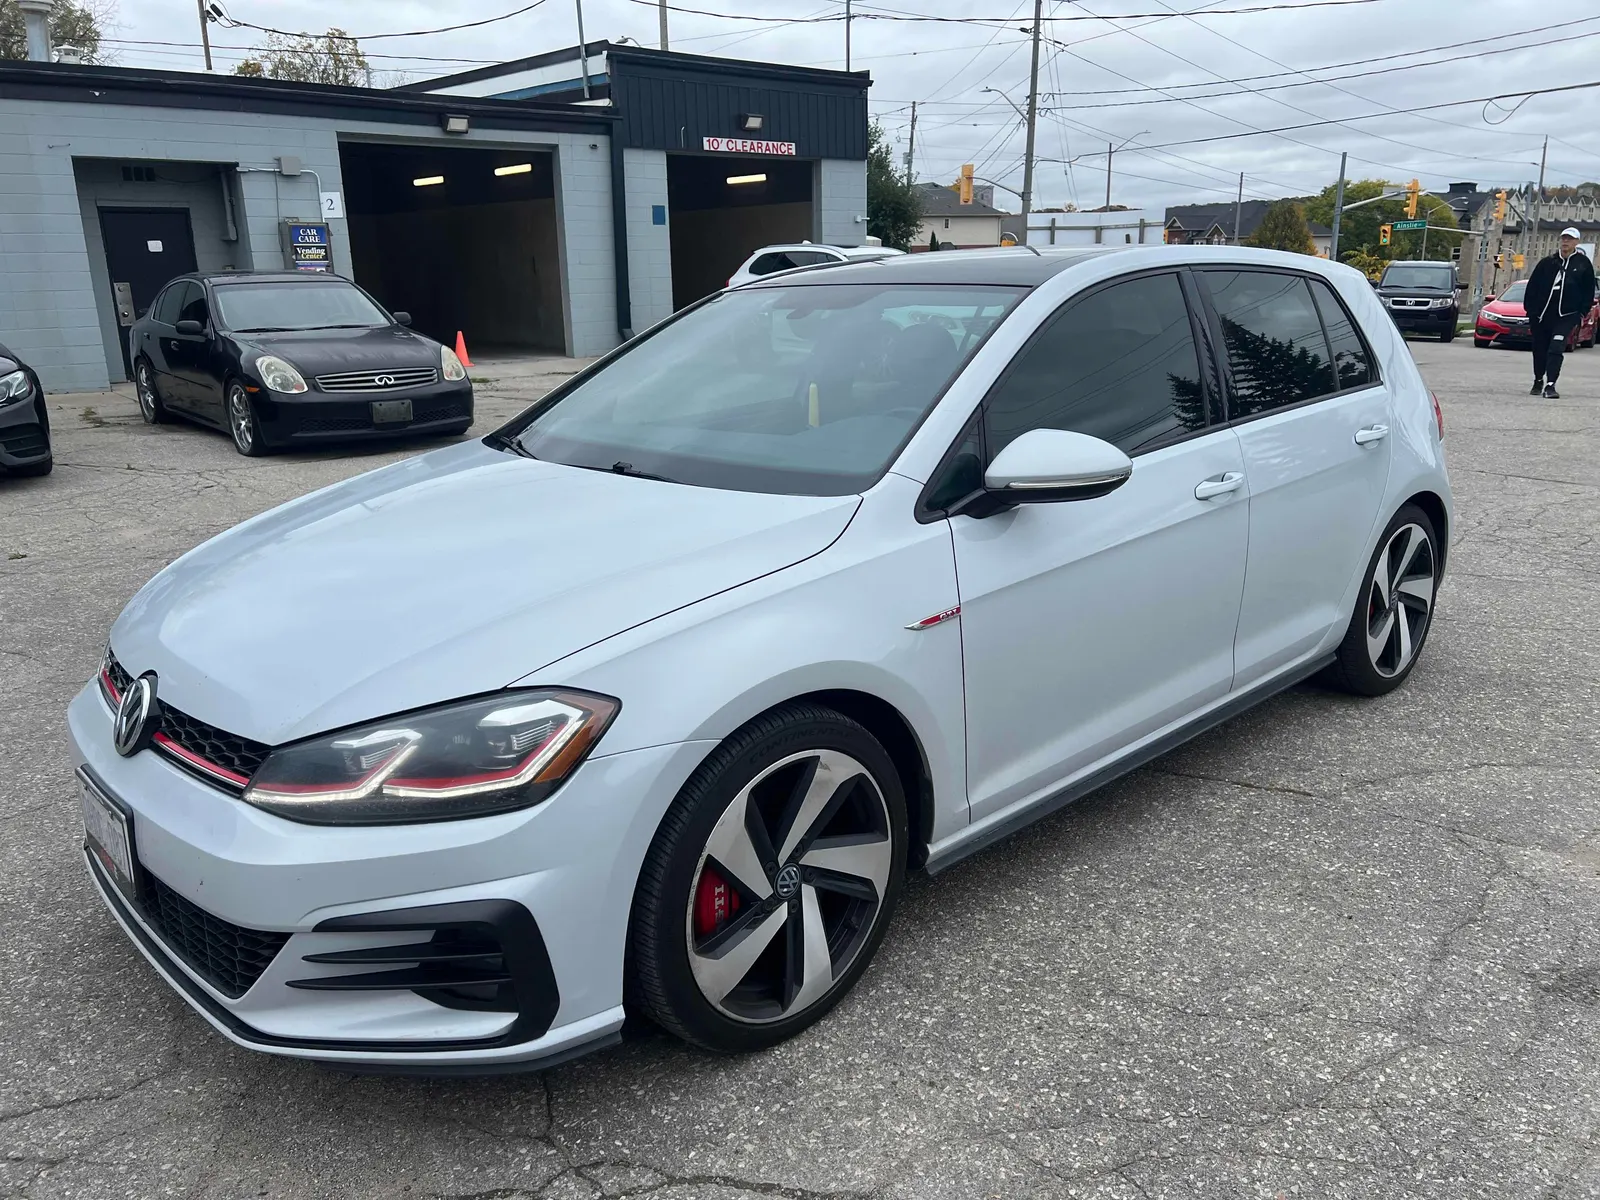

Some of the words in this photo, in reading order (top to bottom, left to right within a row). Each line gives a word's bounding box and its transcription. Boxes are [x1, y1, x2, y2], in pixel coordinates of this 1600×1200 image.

[706, 138, 724, 150] 10'
[726, 140, 793, 155] CLEARANCE
[326, 198, 335, 211] 2
[296, 247, 326, 255] Vending
